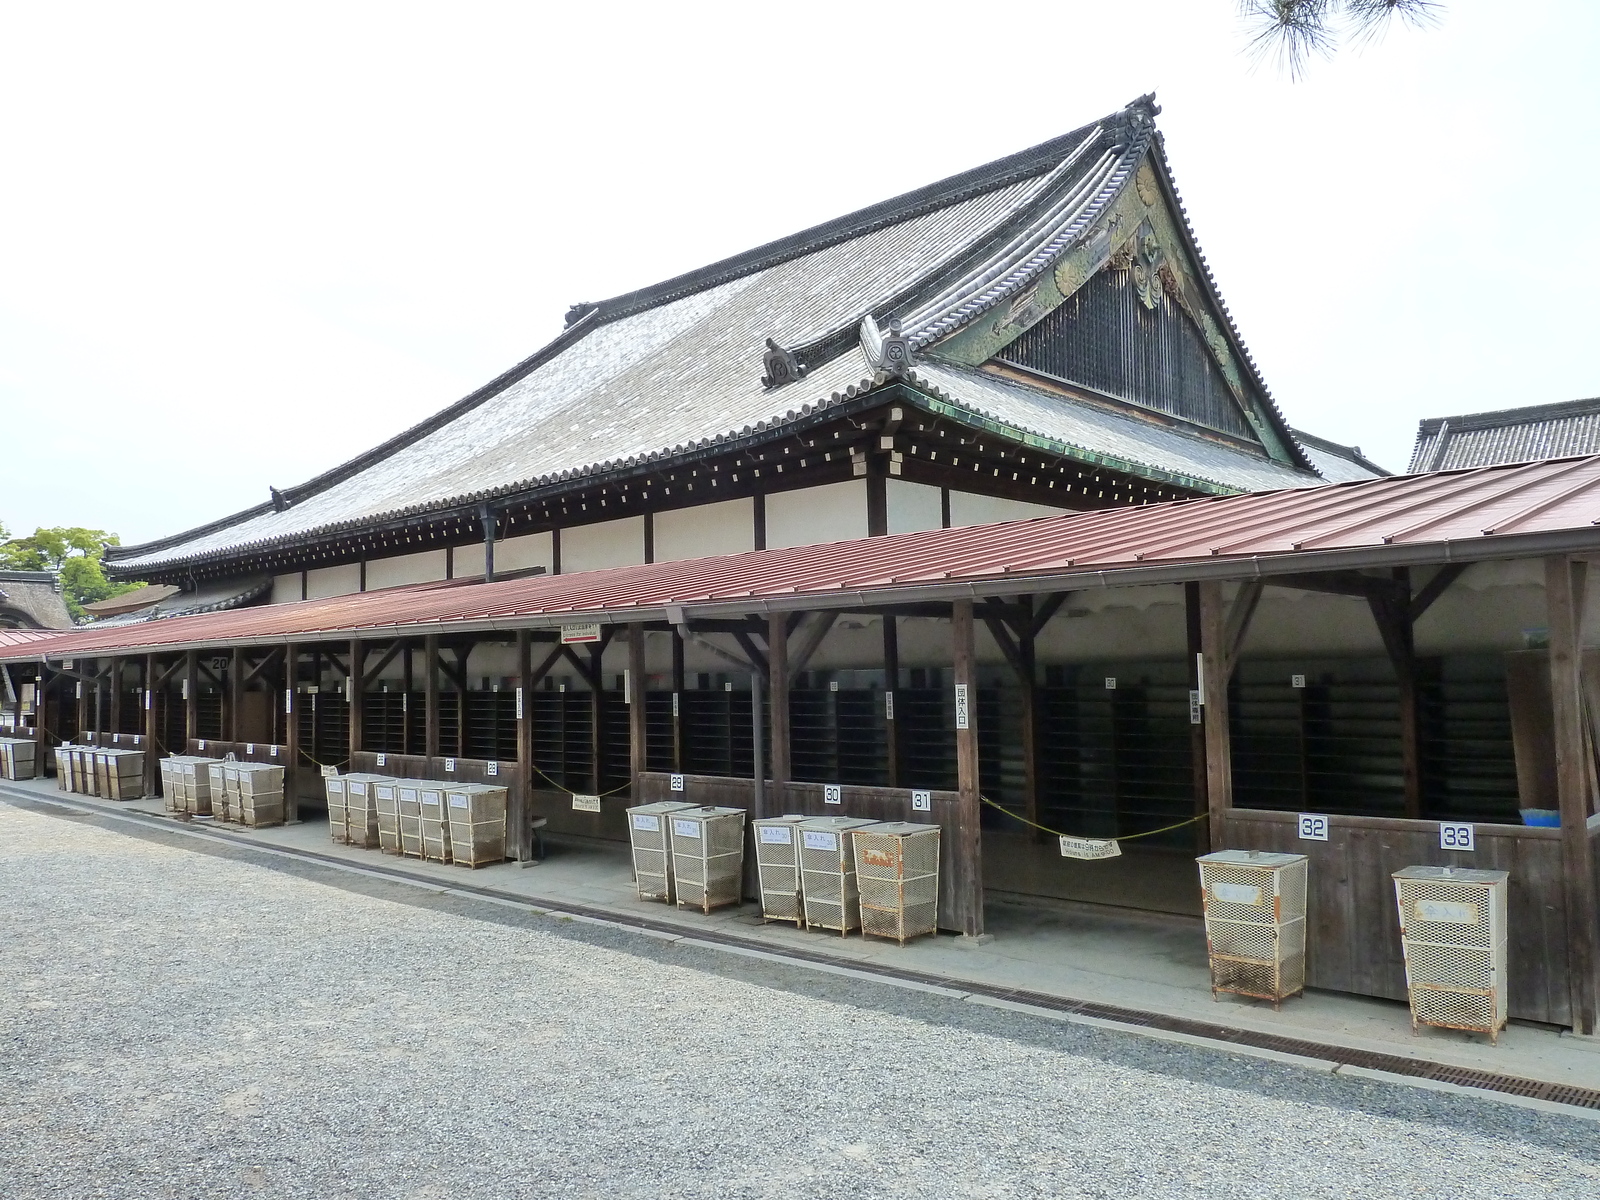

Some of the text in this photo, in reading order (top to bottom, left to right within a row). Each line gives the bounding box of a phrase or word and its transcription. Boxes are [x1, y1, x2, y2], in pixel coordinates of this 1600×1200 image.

[212, 658, 227, 670] 20
[957, 688, 966, 725] 団体入口
[446, 759, 454, 770] 27
[672, 776, 682, 789] 29
[826, 788, 839, 801] 30
[914, 794, 928, 808] 31
[1302, 818, 1325, 837] 32
[1443, 827, 1470, 847] 33
